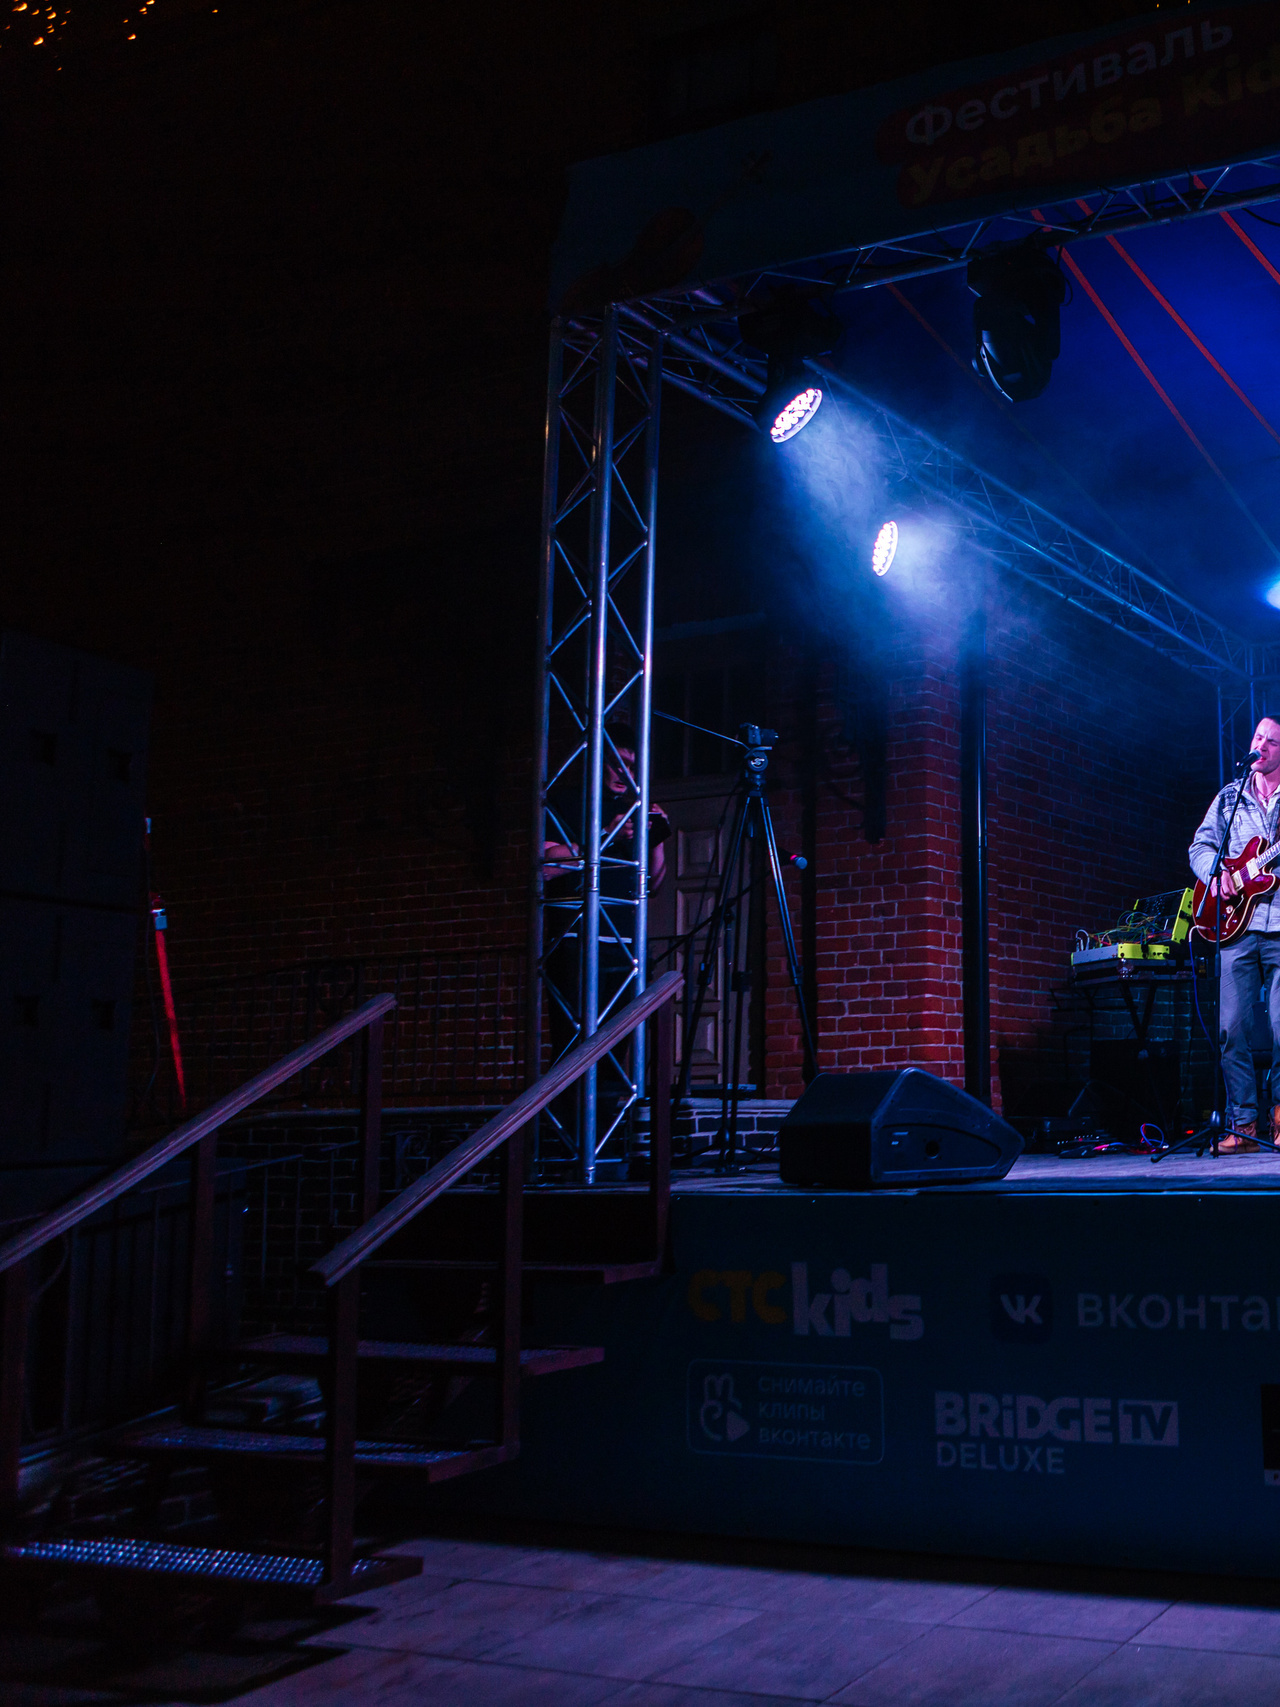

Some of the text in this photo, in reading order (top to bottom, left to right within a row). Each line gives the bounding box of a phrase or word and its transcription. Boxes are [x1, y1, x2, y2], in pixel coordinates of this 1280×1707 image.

[905, 18, 1233, 146] Фестиваль
[908, 95, 1163, 205] Усадьба
[757, 1374, 866, 1398] снимайте
[757, 1401, 826, 1423] клипы
[1122, 1401, 1180, 1446] TV
[935, 1441, 1066, 1475] DELUXE
